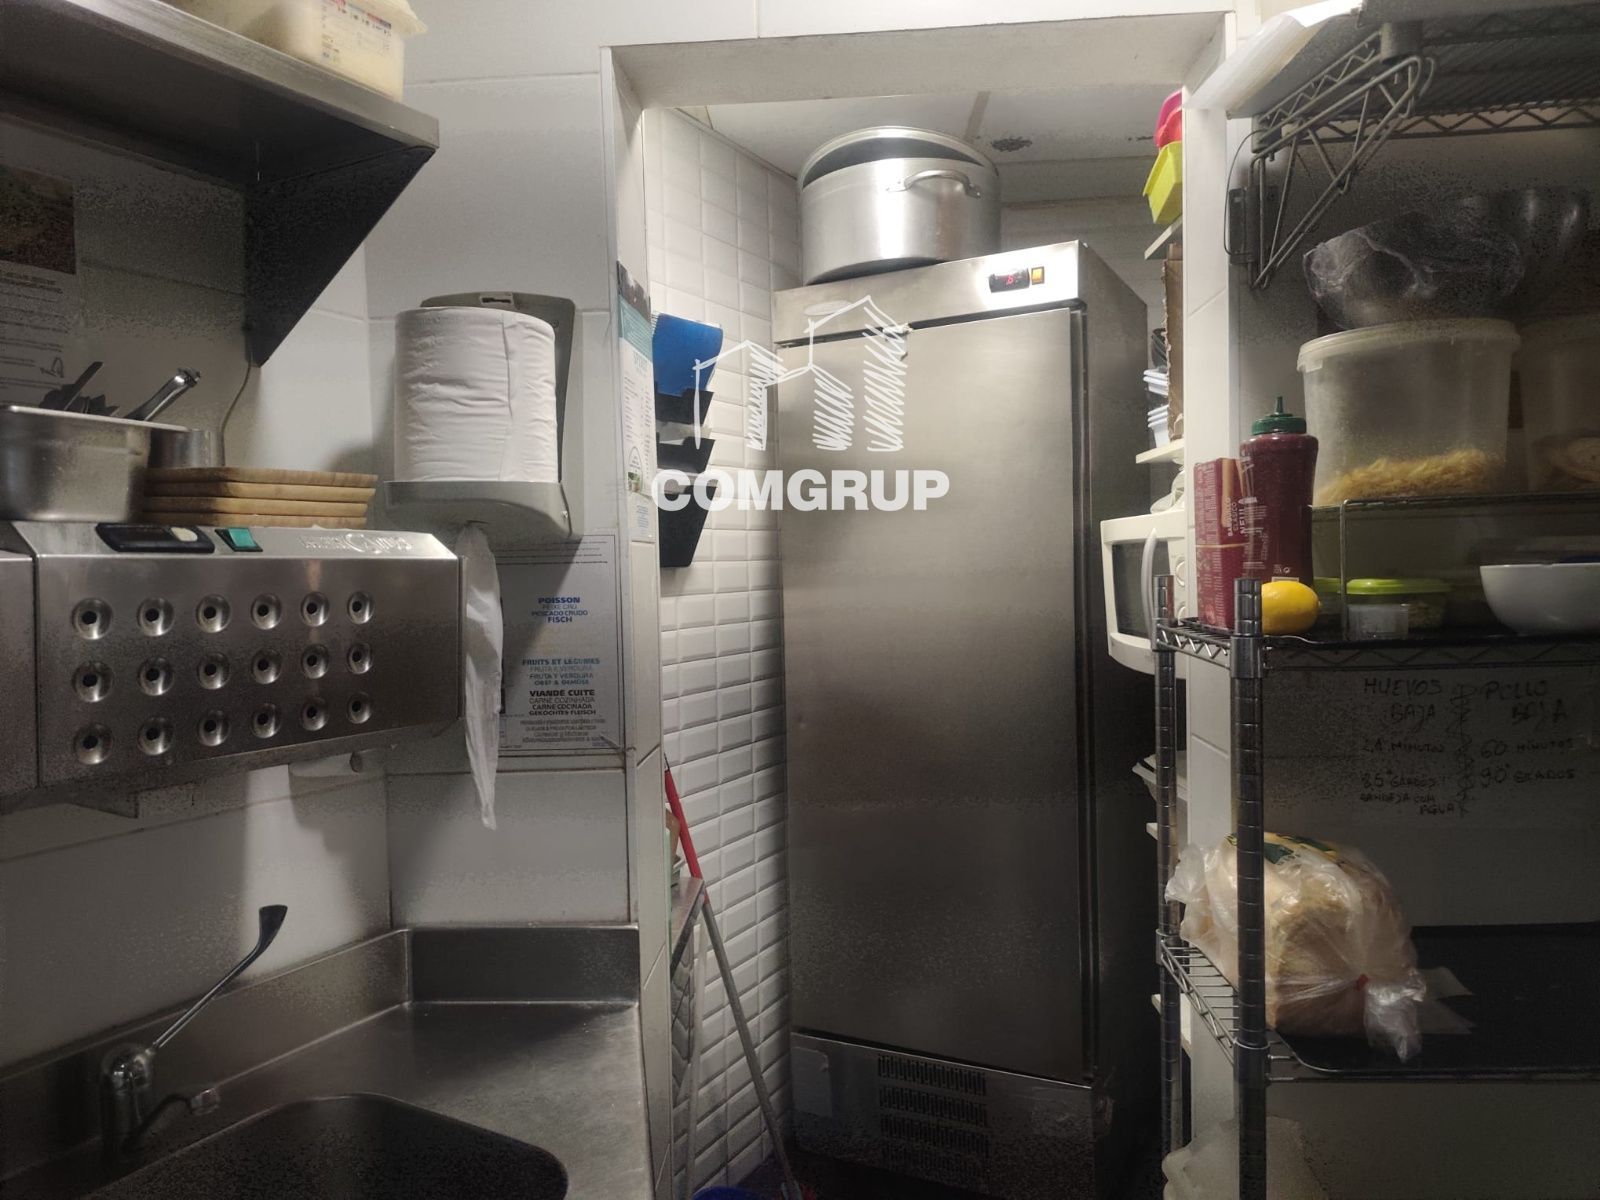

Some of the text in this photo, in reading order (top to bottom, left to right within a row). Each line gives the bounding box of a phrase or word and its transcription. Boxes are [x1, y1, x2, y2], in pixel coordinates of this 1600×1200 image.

[522, 658, 550, 666] FRUITS
[1364, 678, 1443, 696] HUEVOS
[1484, 679, 1549, 700] POLLO
